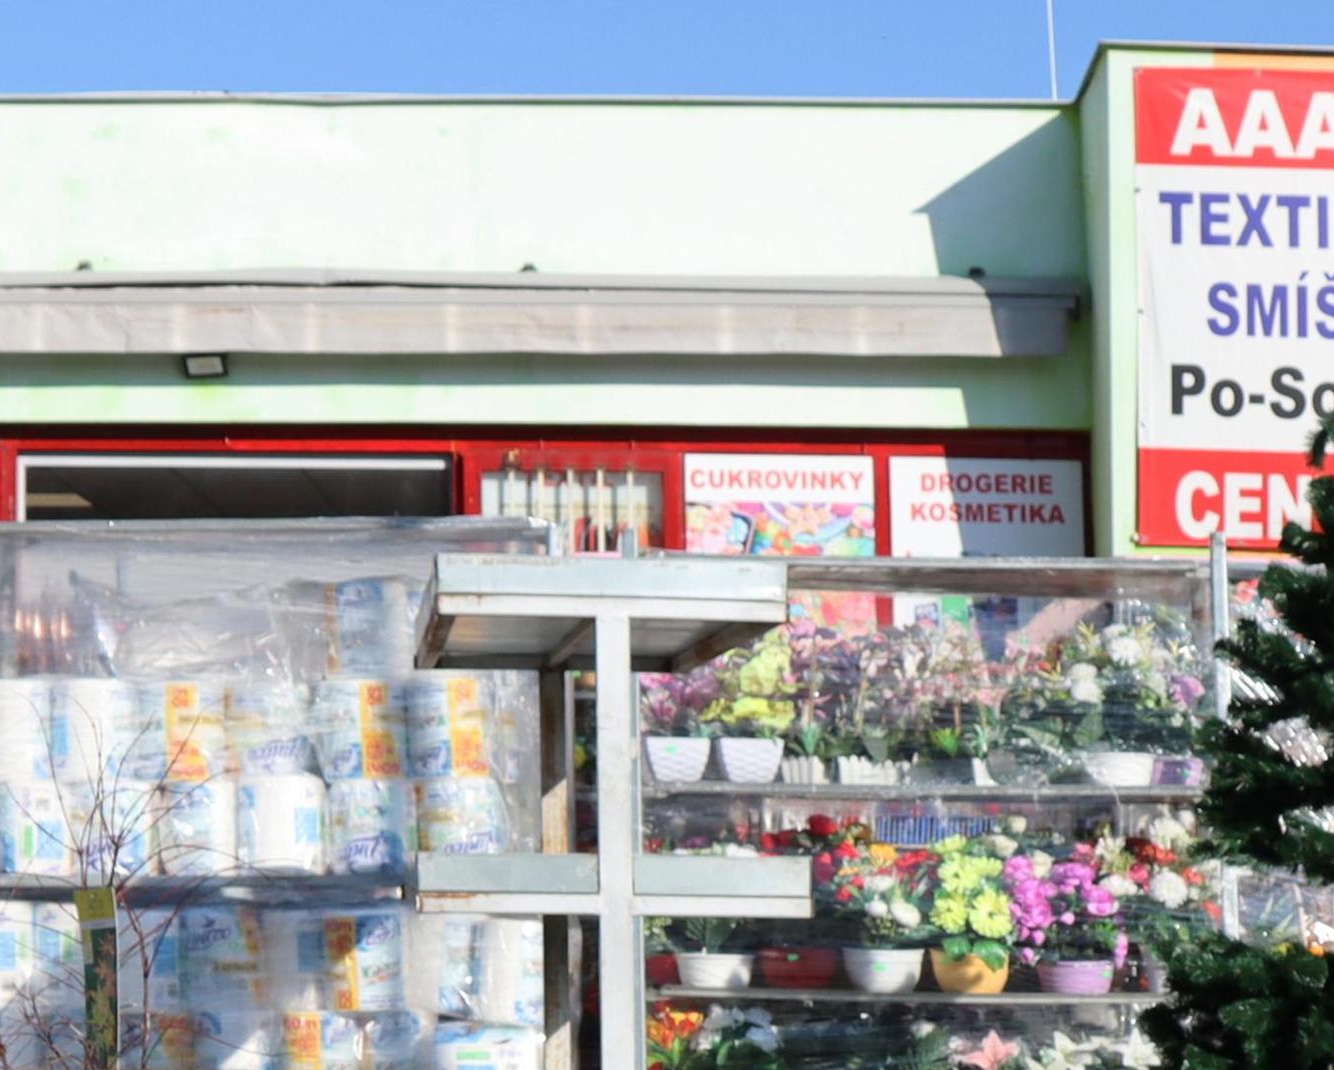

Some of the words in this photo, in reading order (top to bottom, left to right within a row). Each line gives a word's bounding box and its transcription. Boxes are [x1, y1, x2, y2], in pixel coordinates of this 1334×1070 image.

[690, 468, 864, 492] CUKROVINKY
[919, 473, 1053, 495] DROGERIE
[910, 502, 1066, 525] KOSMETIKA
